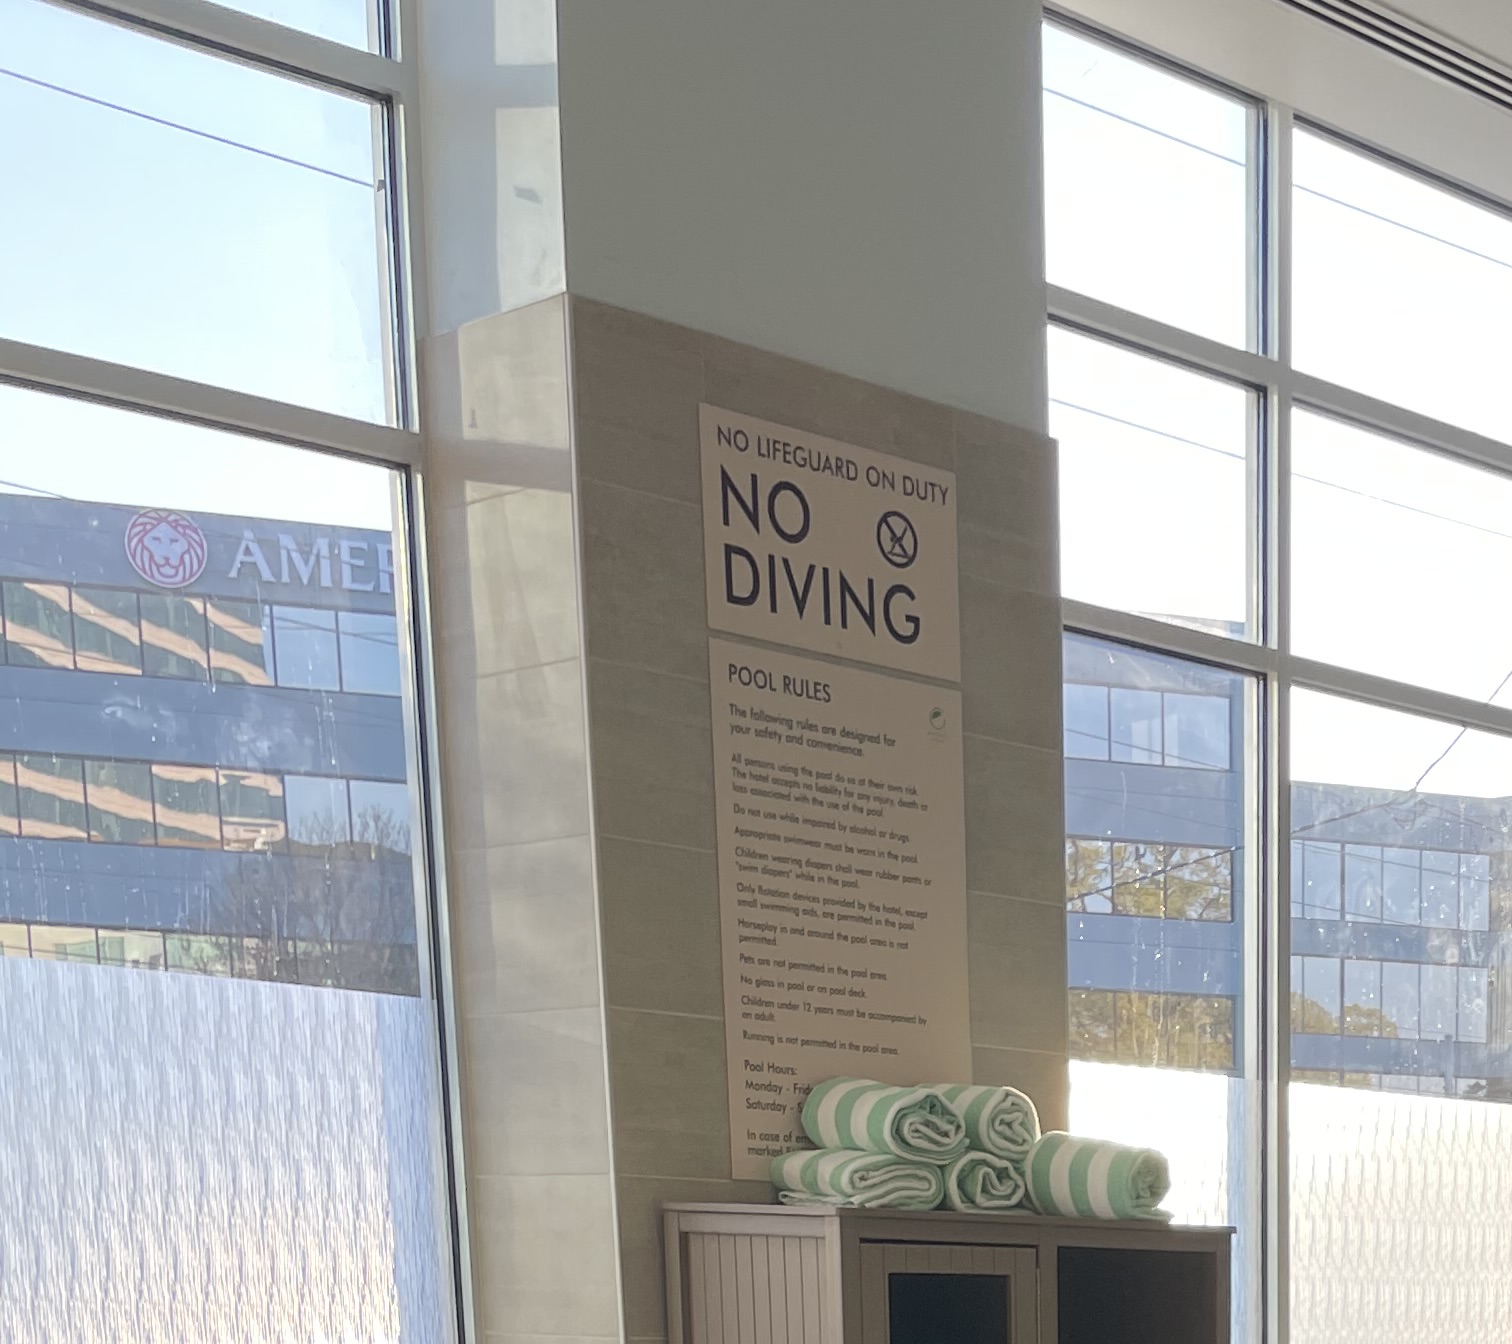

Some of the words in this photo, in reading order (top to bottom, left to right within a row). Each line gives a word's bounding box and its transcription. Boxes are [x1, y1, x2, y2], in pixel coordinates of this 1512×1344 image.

[717, 424, 749, 452] NO
[757, 434, 858, 482] LIFEGUARD
[866, 465, 896, 491] ON
[903, 474, 949, 506] DUTY
[720, 464, 811, 544] NO
[724, 543, 921, 645] DIVING
[727, 662, 776, 692] POOL
[782, 674, 831, 703] RULES
[729, 702, 747, 718] The
[749, 706, 793, 730] following
[796, 716, 818, 732] rules
[821, 725, 836, 736] are
[839, 725, 881, 747] designed
[883, 733, 896, 747] for
[729, 723, 751, 739] your
[754, 724, 782, 744] safety
[785, 731, 803, 745] and
[731, 752, 741, 763] All
[744, 758, 774, 771] persons
[778, 764, 798, 777] using
[800, 765, 812, 777] the
[815, 768, 832, 782] pool
[835, 772, 844, 782] do
[868, 778, 884, 790] their
[732, 766, 746, 779] The
[749, 770, 769, 783] hotel
[771, 776, 800, 790] accepts
[815, 782, 841, 798] liability
[844, 787, 853, 798] for
[857, 792, 870, 802] any
[749, 785, 791, 801] associated
[794, 792, 809, 803] with
[811, 796, 824, 807] the
[826, 801, 839, 810] use
[842, 800, 849, 811] of
[852, 803, 863, 813] the
[733, 802, 745, 814] Do
[747, 808, 760, 817] not
[763, 811, 776, 820] use
[779, 811, 799, 823] while
[802, 815, 835, 831] impaired
[838, 821, 847, 833] by
[849, 823, 876, 837] alcohol
[734, 825, 781, 843] Appropriate
[824, 841, 842, 851] must
[844, 842, 854, 853] be
[887, 849, 898, 861] the
[734, 846, 768, 861] Children
[772, 854, 802, 868] wearing
[835, 862, 852, 874] shall
[875, 868, 899, 881] rubber
[795, 869, 815, 881] while
[827, 875, 839, 885] the
[736, 881, 755, 894] Only
[792, 891, 820, 903] devices
[822, 894, 855, 910] provided
[857, 900, 866, 912] by
[868, 902, 880, 912] the
[905, 908, 927, 920] except
[737, 896, 757, 908] small
[760, 902, 799, 916] swimming
[822, 911, 834, 919] are
[837, 910, 873, 926] permitted
[884, 917, 896, 927] the
[737, 917, 777, 934] Horseplay
[789, 925, 805, 936] and
[807, 927, 834, 940] around
[836, 931, 848, 941] the
[850, 933, 867, 946] pool
[869, 938, 887, 947] area
[896, 940, 908, 949] not
[739, 952, 755, 964] Pets
[757, 957, 770, 966] are
[773, 958, 786, 968] not
[788, 958, 825, 975] permitted
[836, 965, 848, 975] the
[850, 966, 867, 980] pool
[740, 974, 752, 984] No
[755, 976, 774, 989] glass
[786, 979, 804, 993] pool
[829, 984, 846, 997] pool
[741, 994, 774, 1008] Children
[777, 999, 799, 1011] under
[803, 1001, 811, 1012] 12
[814, 1006, 834, 1017] years
[836, 1007, 854, 1017] must
[856, 1008, 866, 1018] be
[868, 1009, 916, 1025] accompanied
[918, 1015, 927, 1026] by
[742, 1029, 775, 1044] Running
[785, 1036, 798, 1044] not
[800, 1036, 837, 1050] permitted
[848, 1041, 860, 1051] the
[862, 1042, 879, 1054] pool
[744, 1059, 764, 1072] Pool
[767, 1061, 797, 1075] Hours:
[745, 1078, 783, 1095] Monday
[745, 1097, 787, 1114] Saturday
[747, 1129, 756, 1140] In
[759, 1131, 779, 1142] case
[783, 1130, 792, 1143] of
